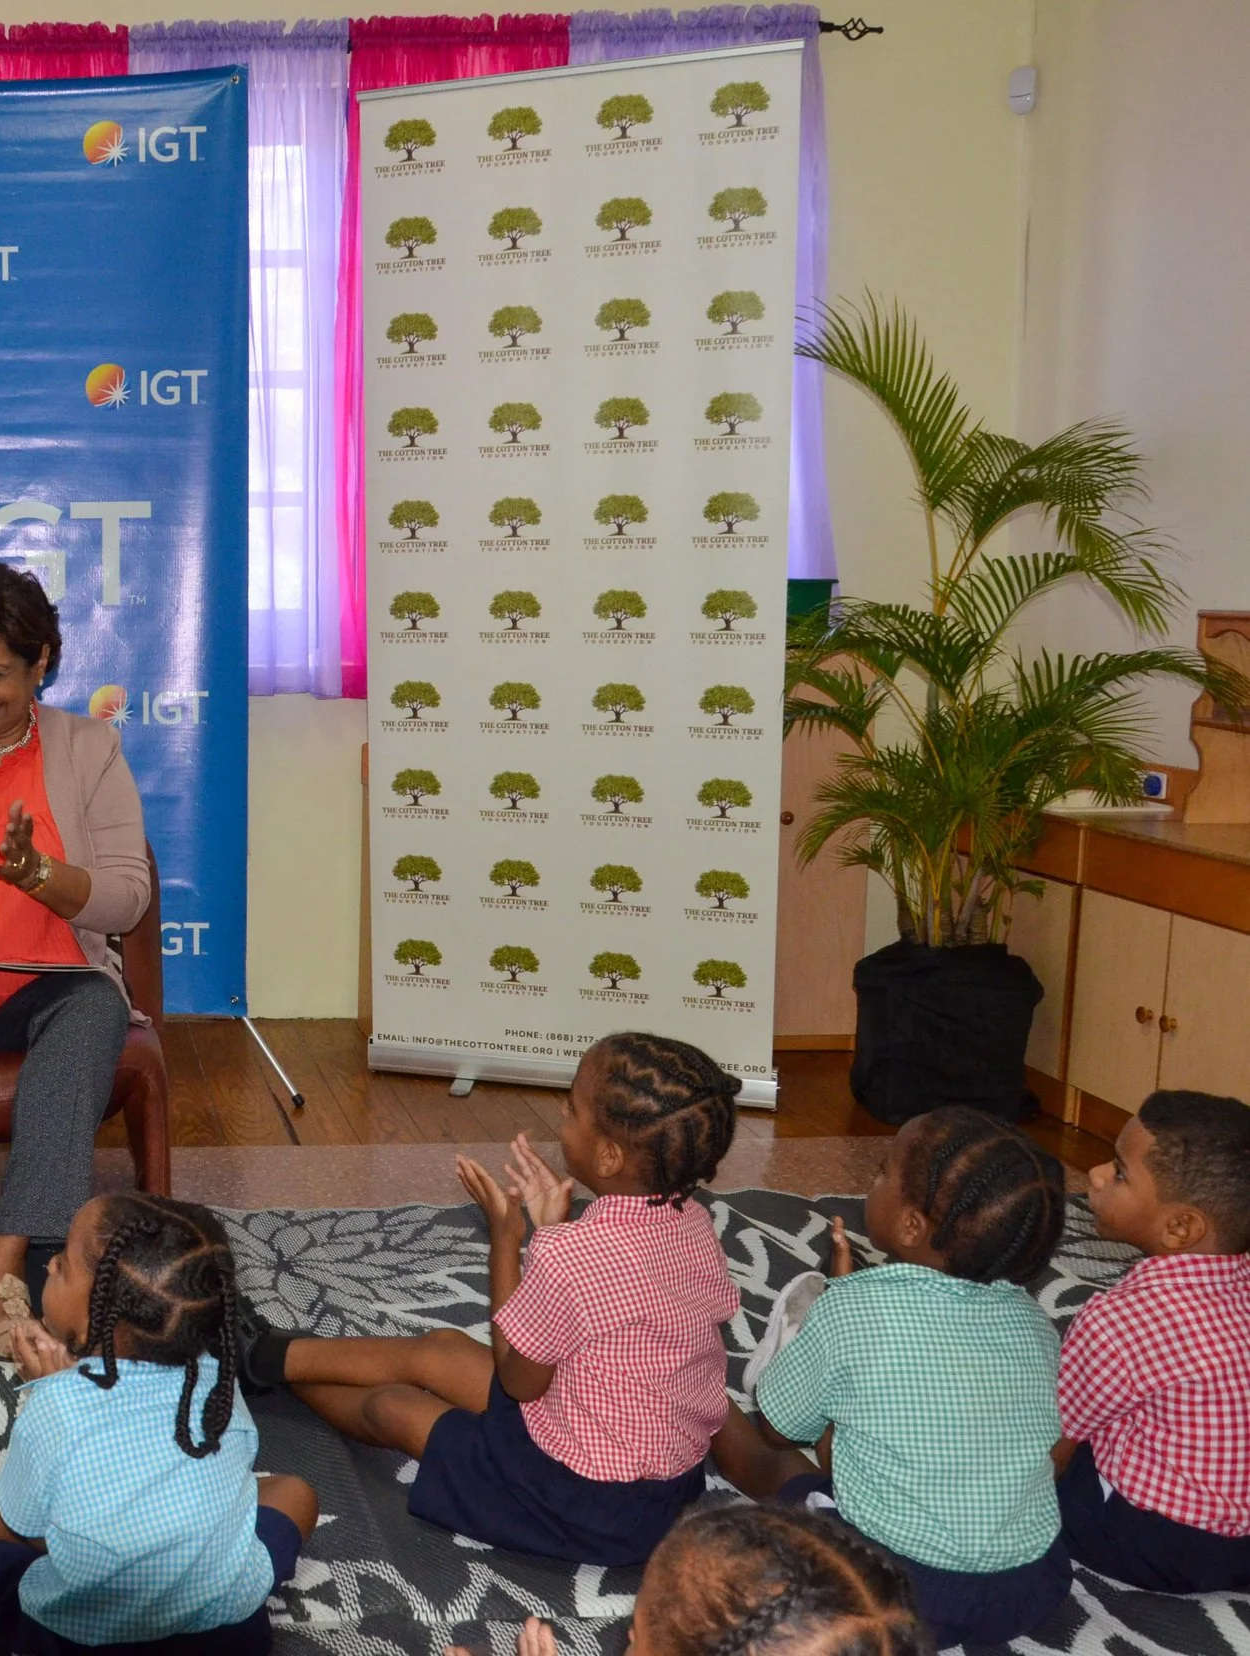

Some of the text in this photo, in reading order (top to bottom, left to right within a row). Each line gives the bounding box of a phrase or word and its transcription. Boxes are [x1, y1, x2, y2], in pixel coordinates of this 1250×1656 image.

[698, 126, 780, 141] THE COTTON TREE
[138, 126, 206, 162] IGT
[584, 137, 663, 152] THE COTTON TREE
[477, 149, 552, 163] THE COTTON TREE
[374, 160, 446, 174] THE COTTON TREE
[696, 231, 777, 245] THE COTTON TREE
[584, 240, 662, 254] THE COTTON TREE
[477, 249, 552, 262] THE COTTON TREE
[375, 258, 446, 270] THE COTTON TREE
[495, 349, 528, 358] COTTON
[530, 347, 551, 356] TREE
[583, 341, 660, 353] THE COTTON TREE
[394, 355, 425, 364] COTTON
[426, 354, 447, 362] TREE
[140, 370, 208, 405] IGT
[496, 445, 528, 453] COTTON
[601, 441, 635, 449] COTTON
[143, 691, 209, 725] IGT
[703, 820, 738, 828] COTTON
[482, 903, 545, 911] FOUNDATION
[496, 898, 527, 906] COTTON
[596, 903, 629, 912] COTTON
[582, 909, 647, 918] FOUNDATION
[701, 910, 735, 918] COTTON
[686, 916, 754, 924] FOUNDATION
[161, 922, 209, 956] GT
[387, 981, 447, 990] FOUNDATION
[400, 976, 430, 984] COTTON
[496, 982, 527, 991] COTTON
[482, 988, 544, 997] FOUNDATION
[595, 990, 627, 999] COTTON
[629, 992, 650, 1000] TREE
[581, 996, 646, 1005] FOUNDATION
[699, 998, 733, 1007] COTTON
[734, 1000, 756, 1009] TREE
[505, 1029, 599, 1043] PHONE: (868) 217-
[377, 1033, 410, 1043] EMAIL:
[412, 1036, 553, 1055] INFO@THECOTTONTREE.ORG
[563, 1050, 585, 1058] WEB
[718, 1063, 767, 1074] REE.ORG
